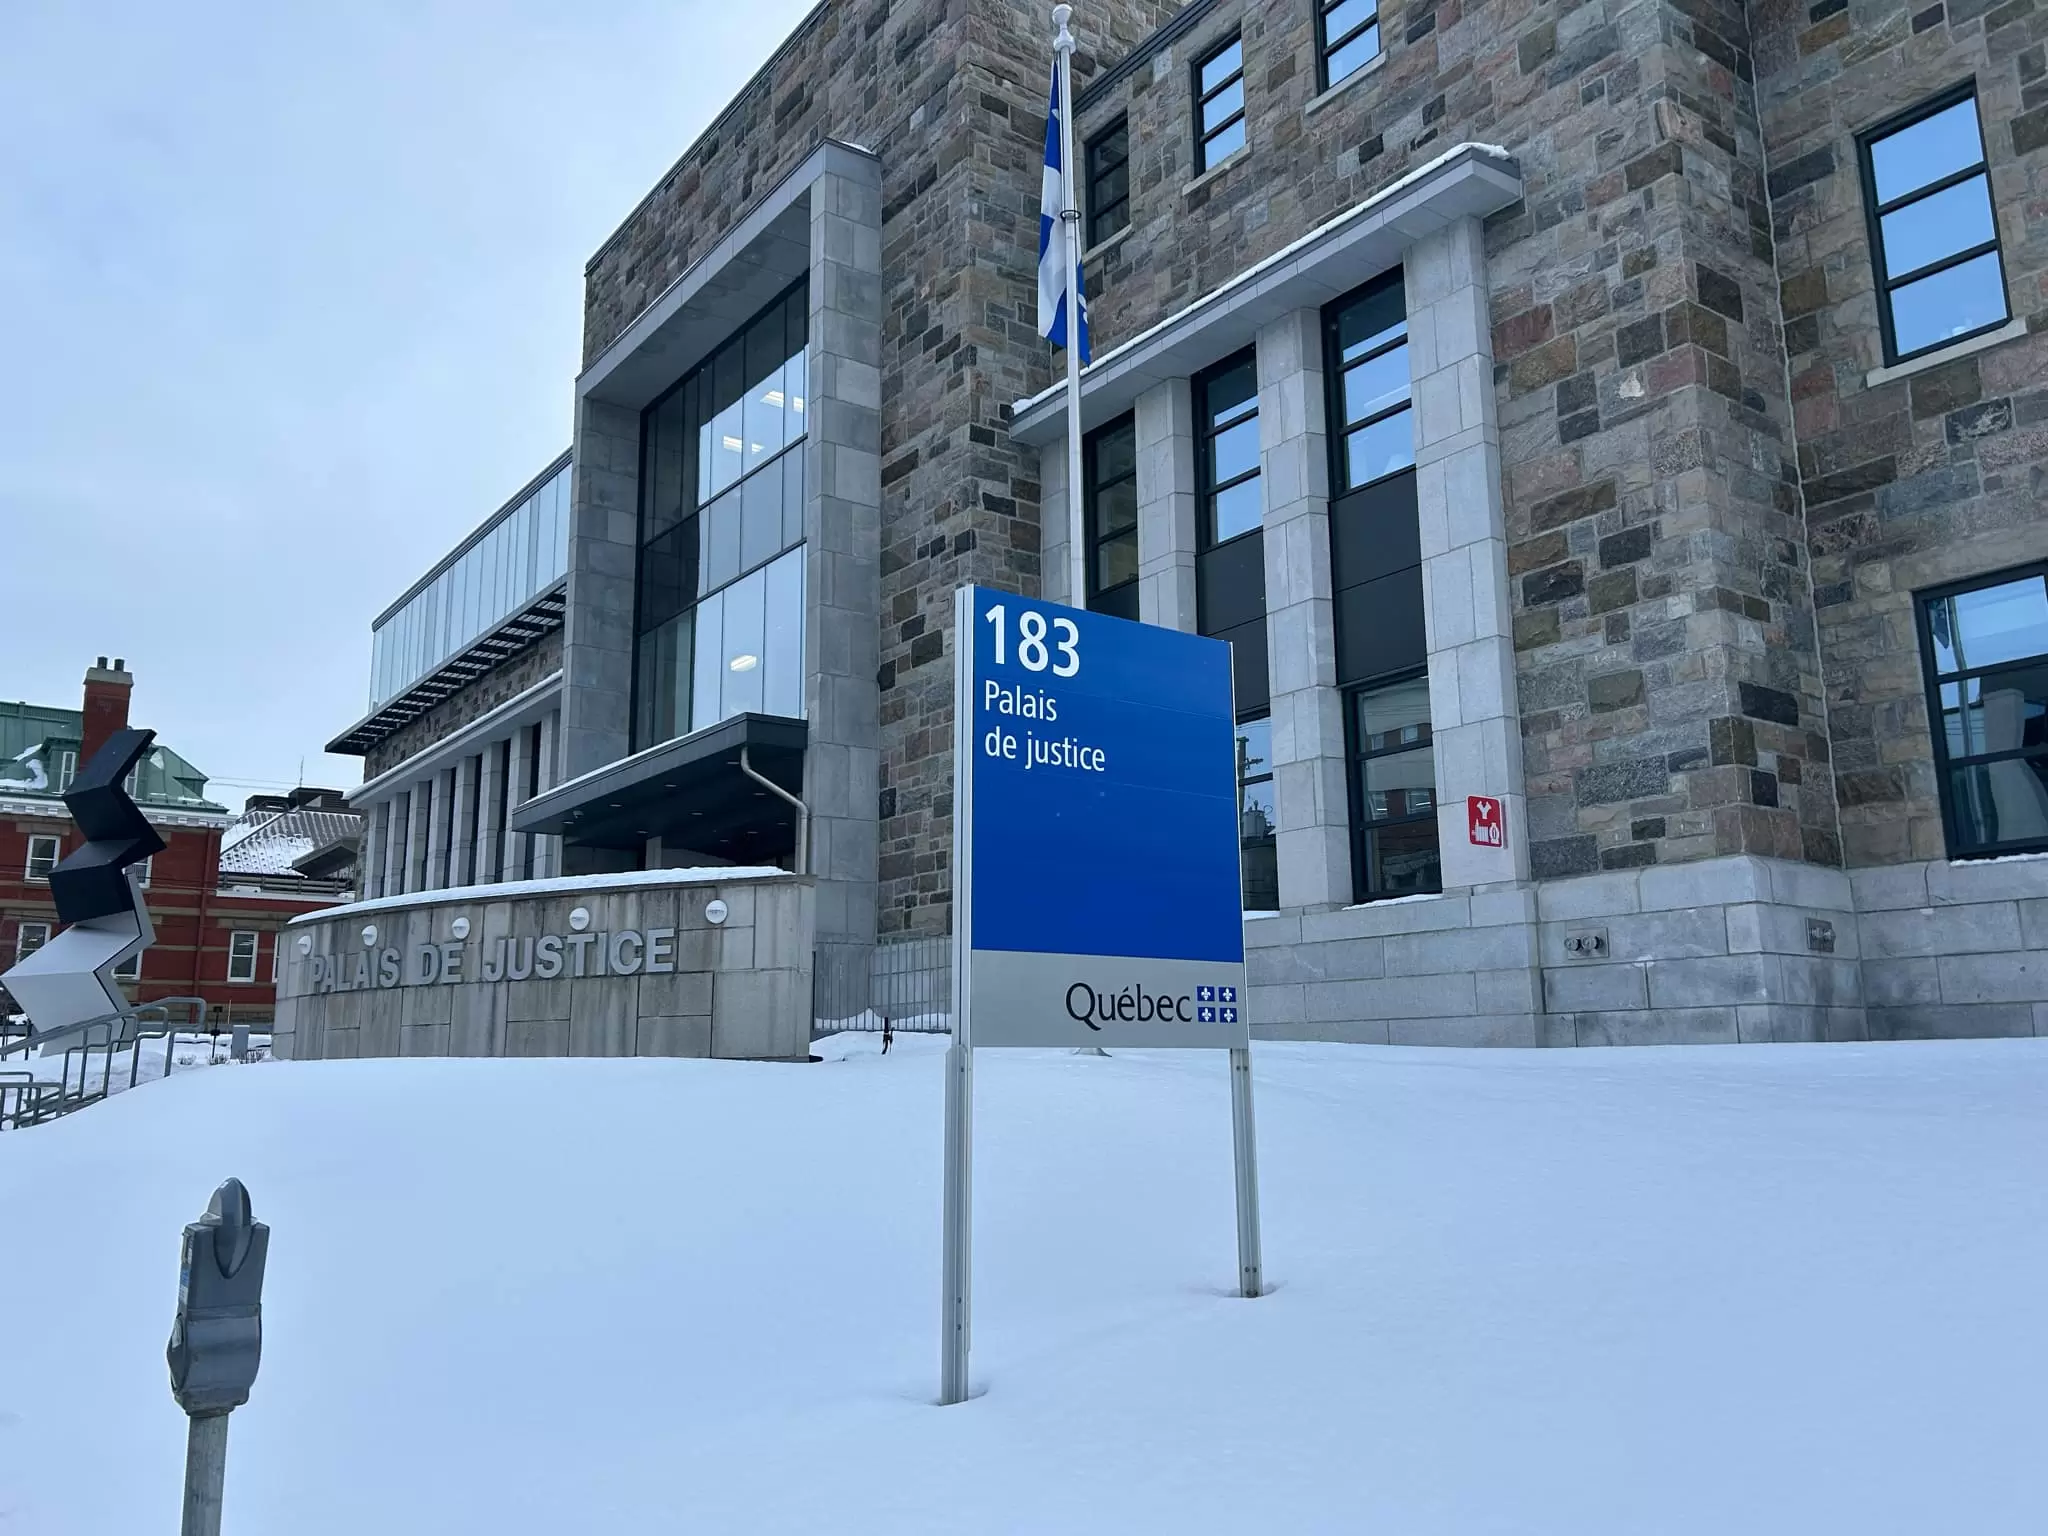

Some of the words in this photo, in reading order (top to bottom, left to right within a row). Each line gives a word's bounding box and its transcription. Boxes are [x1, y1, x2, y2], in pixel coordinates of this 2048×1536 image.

[984, 604, 1081, 678] 183
[984, 679, 1058, 722] Palais
[984, 725, 1017, 760] de
[1024, 730, 1106, 772] justice
[312, 946, 400, 994] PALAIS
[417, 942, 464, 986] DE
[484, 927, 675, 982] JUSTICE
[1065, 982, 1193, 1031] Québec
